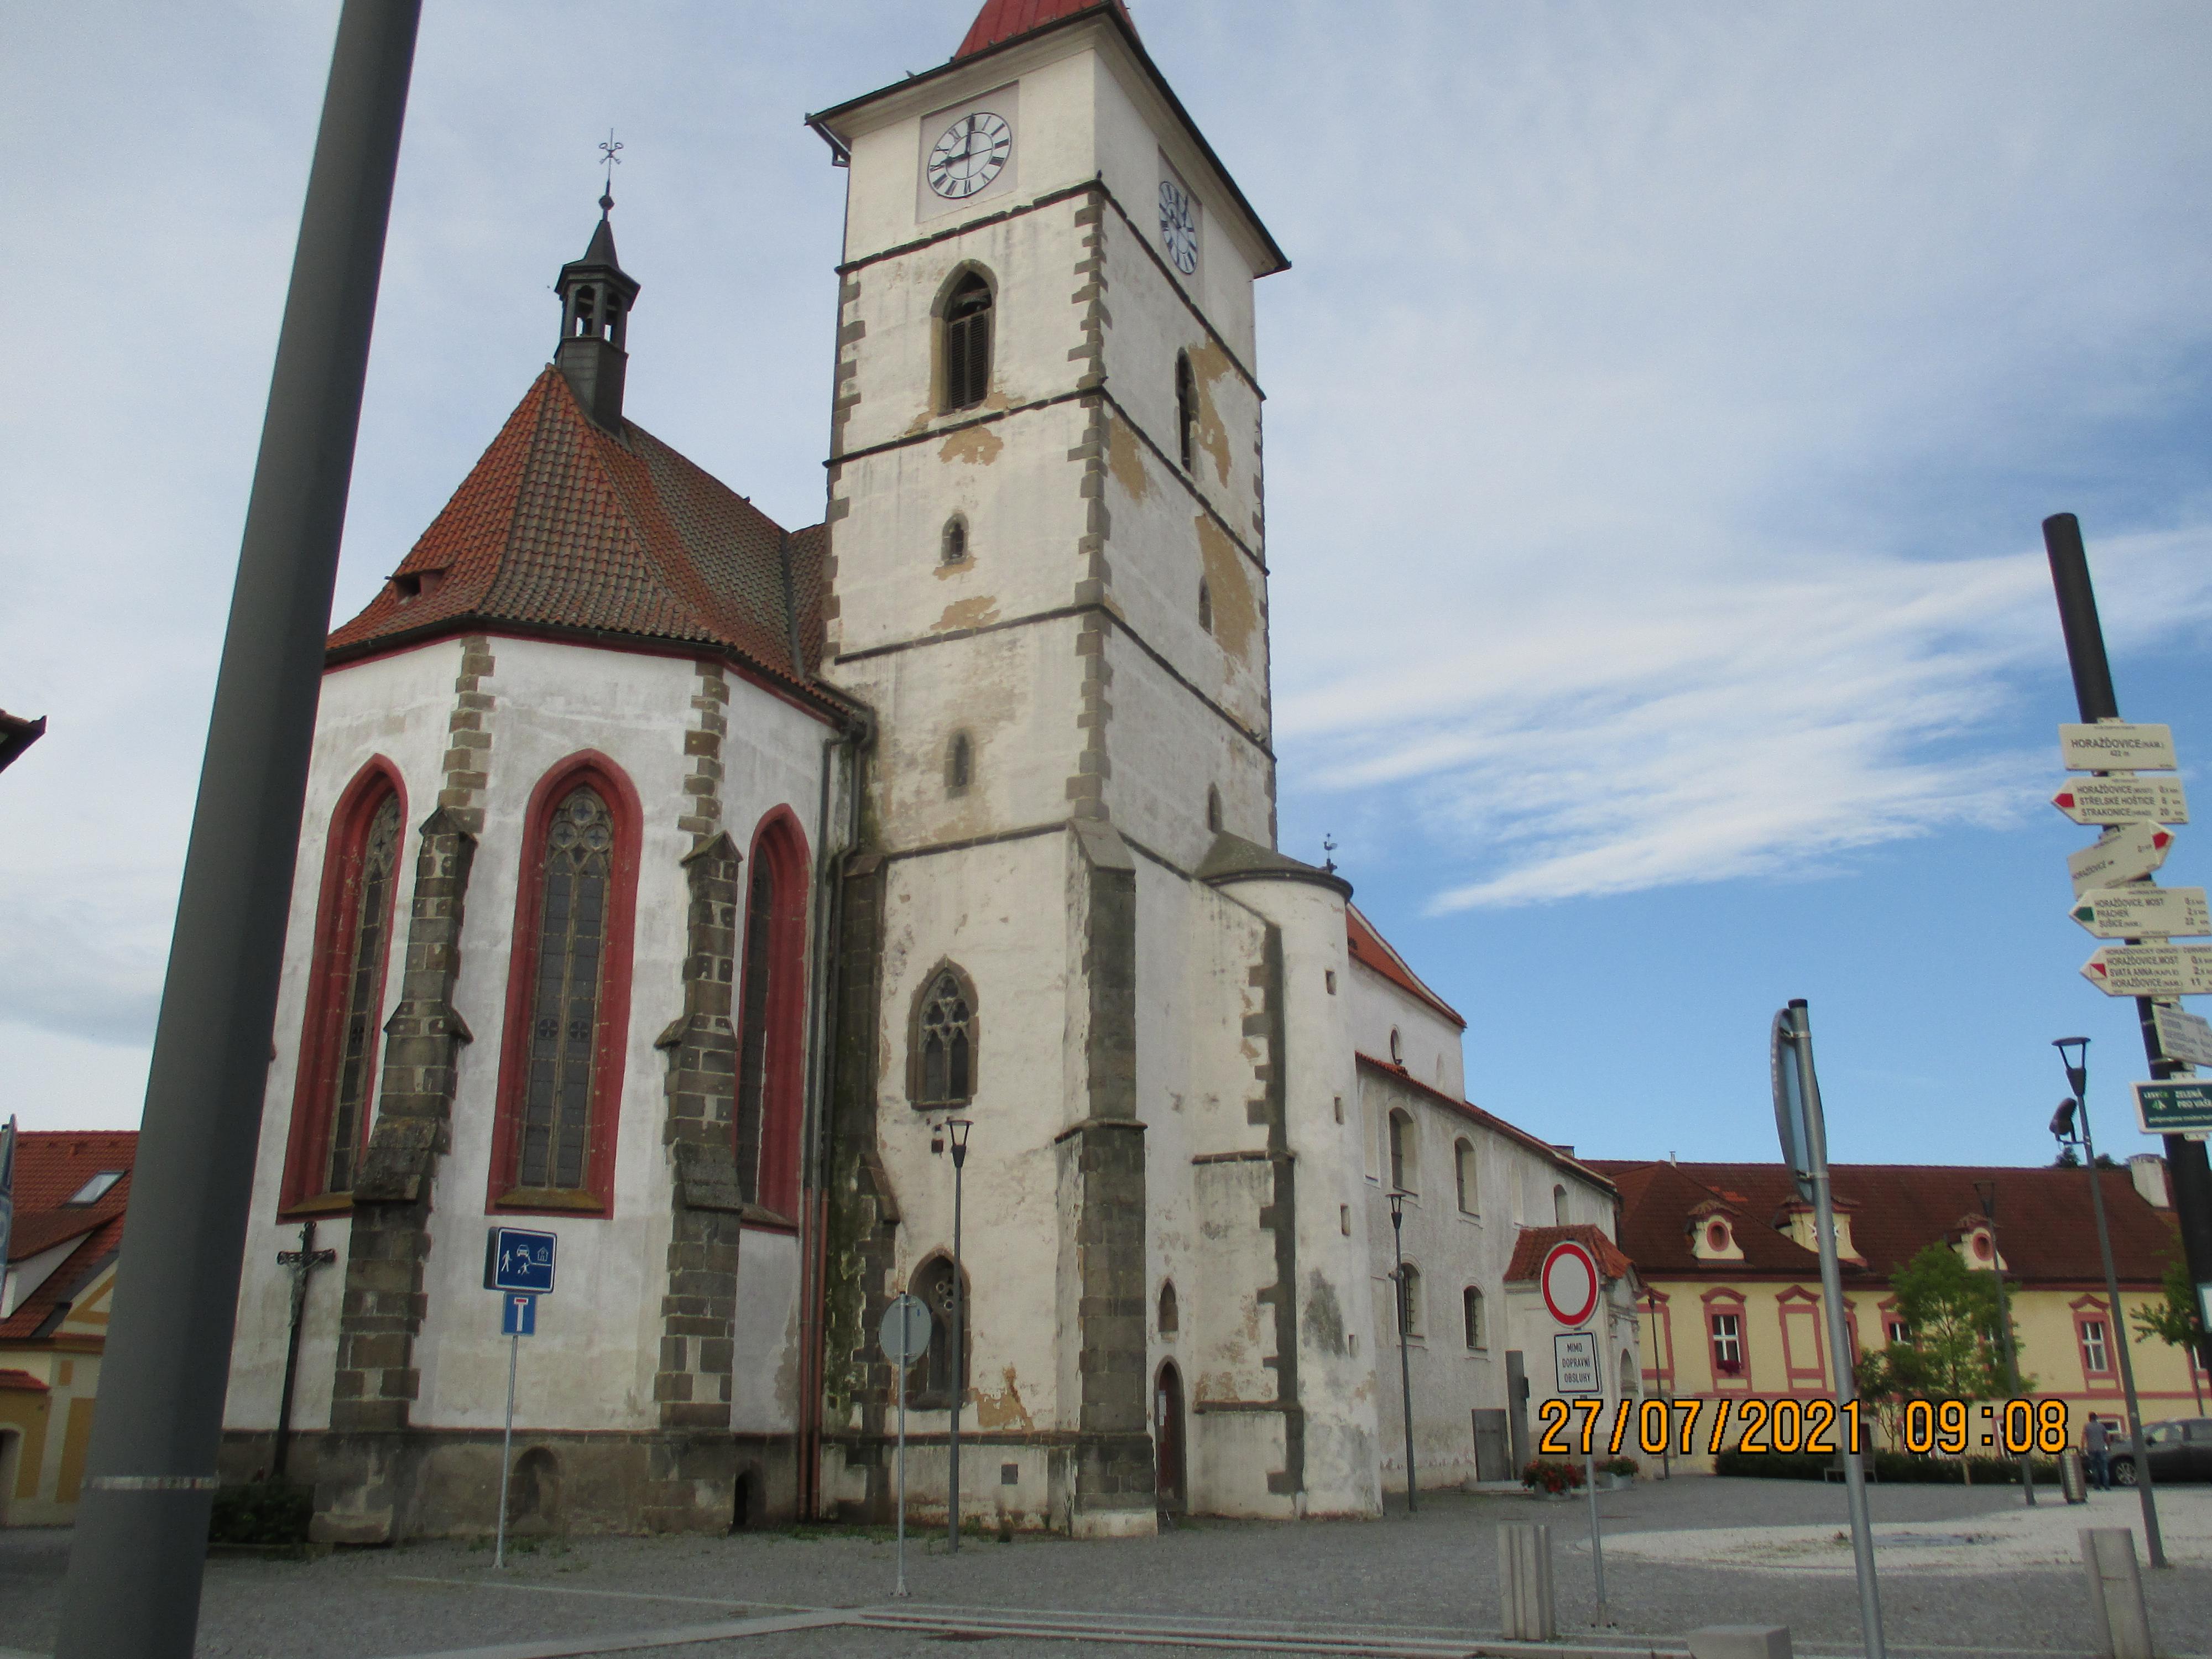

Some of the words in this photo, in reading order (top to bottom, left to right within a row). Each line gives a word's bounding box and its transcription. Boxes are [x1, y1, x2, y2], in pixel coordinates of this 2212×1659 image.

[1567, 1343, 1583, 1353] MIMO
[1562, 1355, 1590, 1368] DOPRAVNÍ
[1564, 1373, 1590, 1383] OBSLUHY
